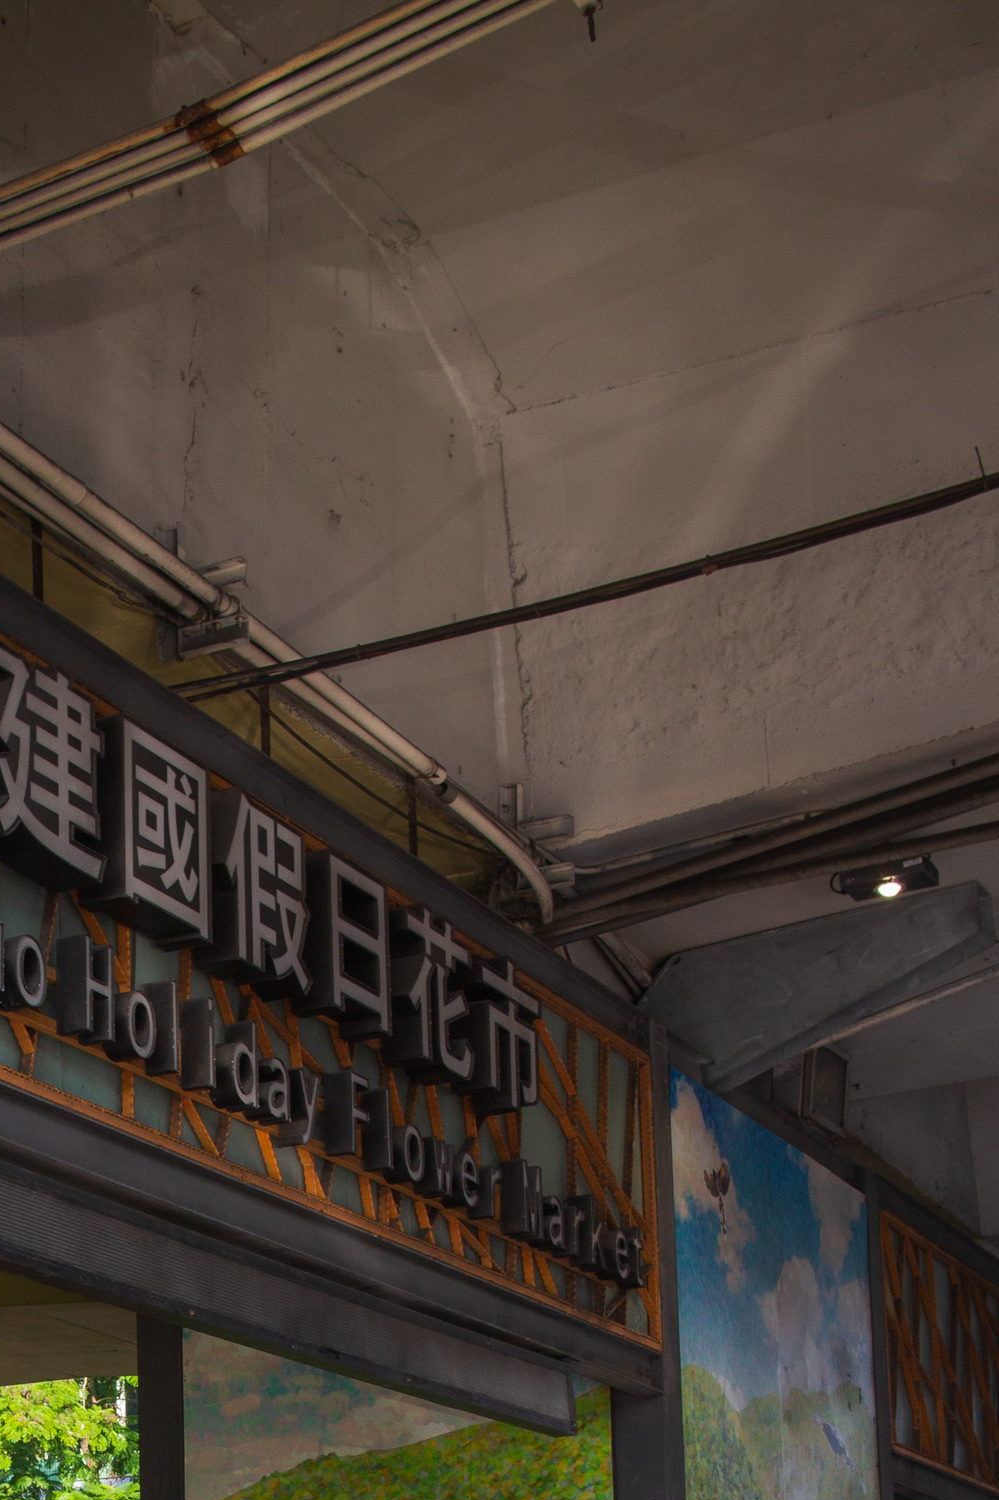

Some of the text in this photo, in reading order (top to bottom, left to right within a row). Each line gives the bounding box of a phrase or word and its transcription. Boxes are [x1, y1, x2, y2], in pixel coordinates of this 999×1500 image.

[68, 935, 319, 1145] Holiday
[336, 1070, 502, 1219] Flower
[510, 1159, 646, 1288] Market
